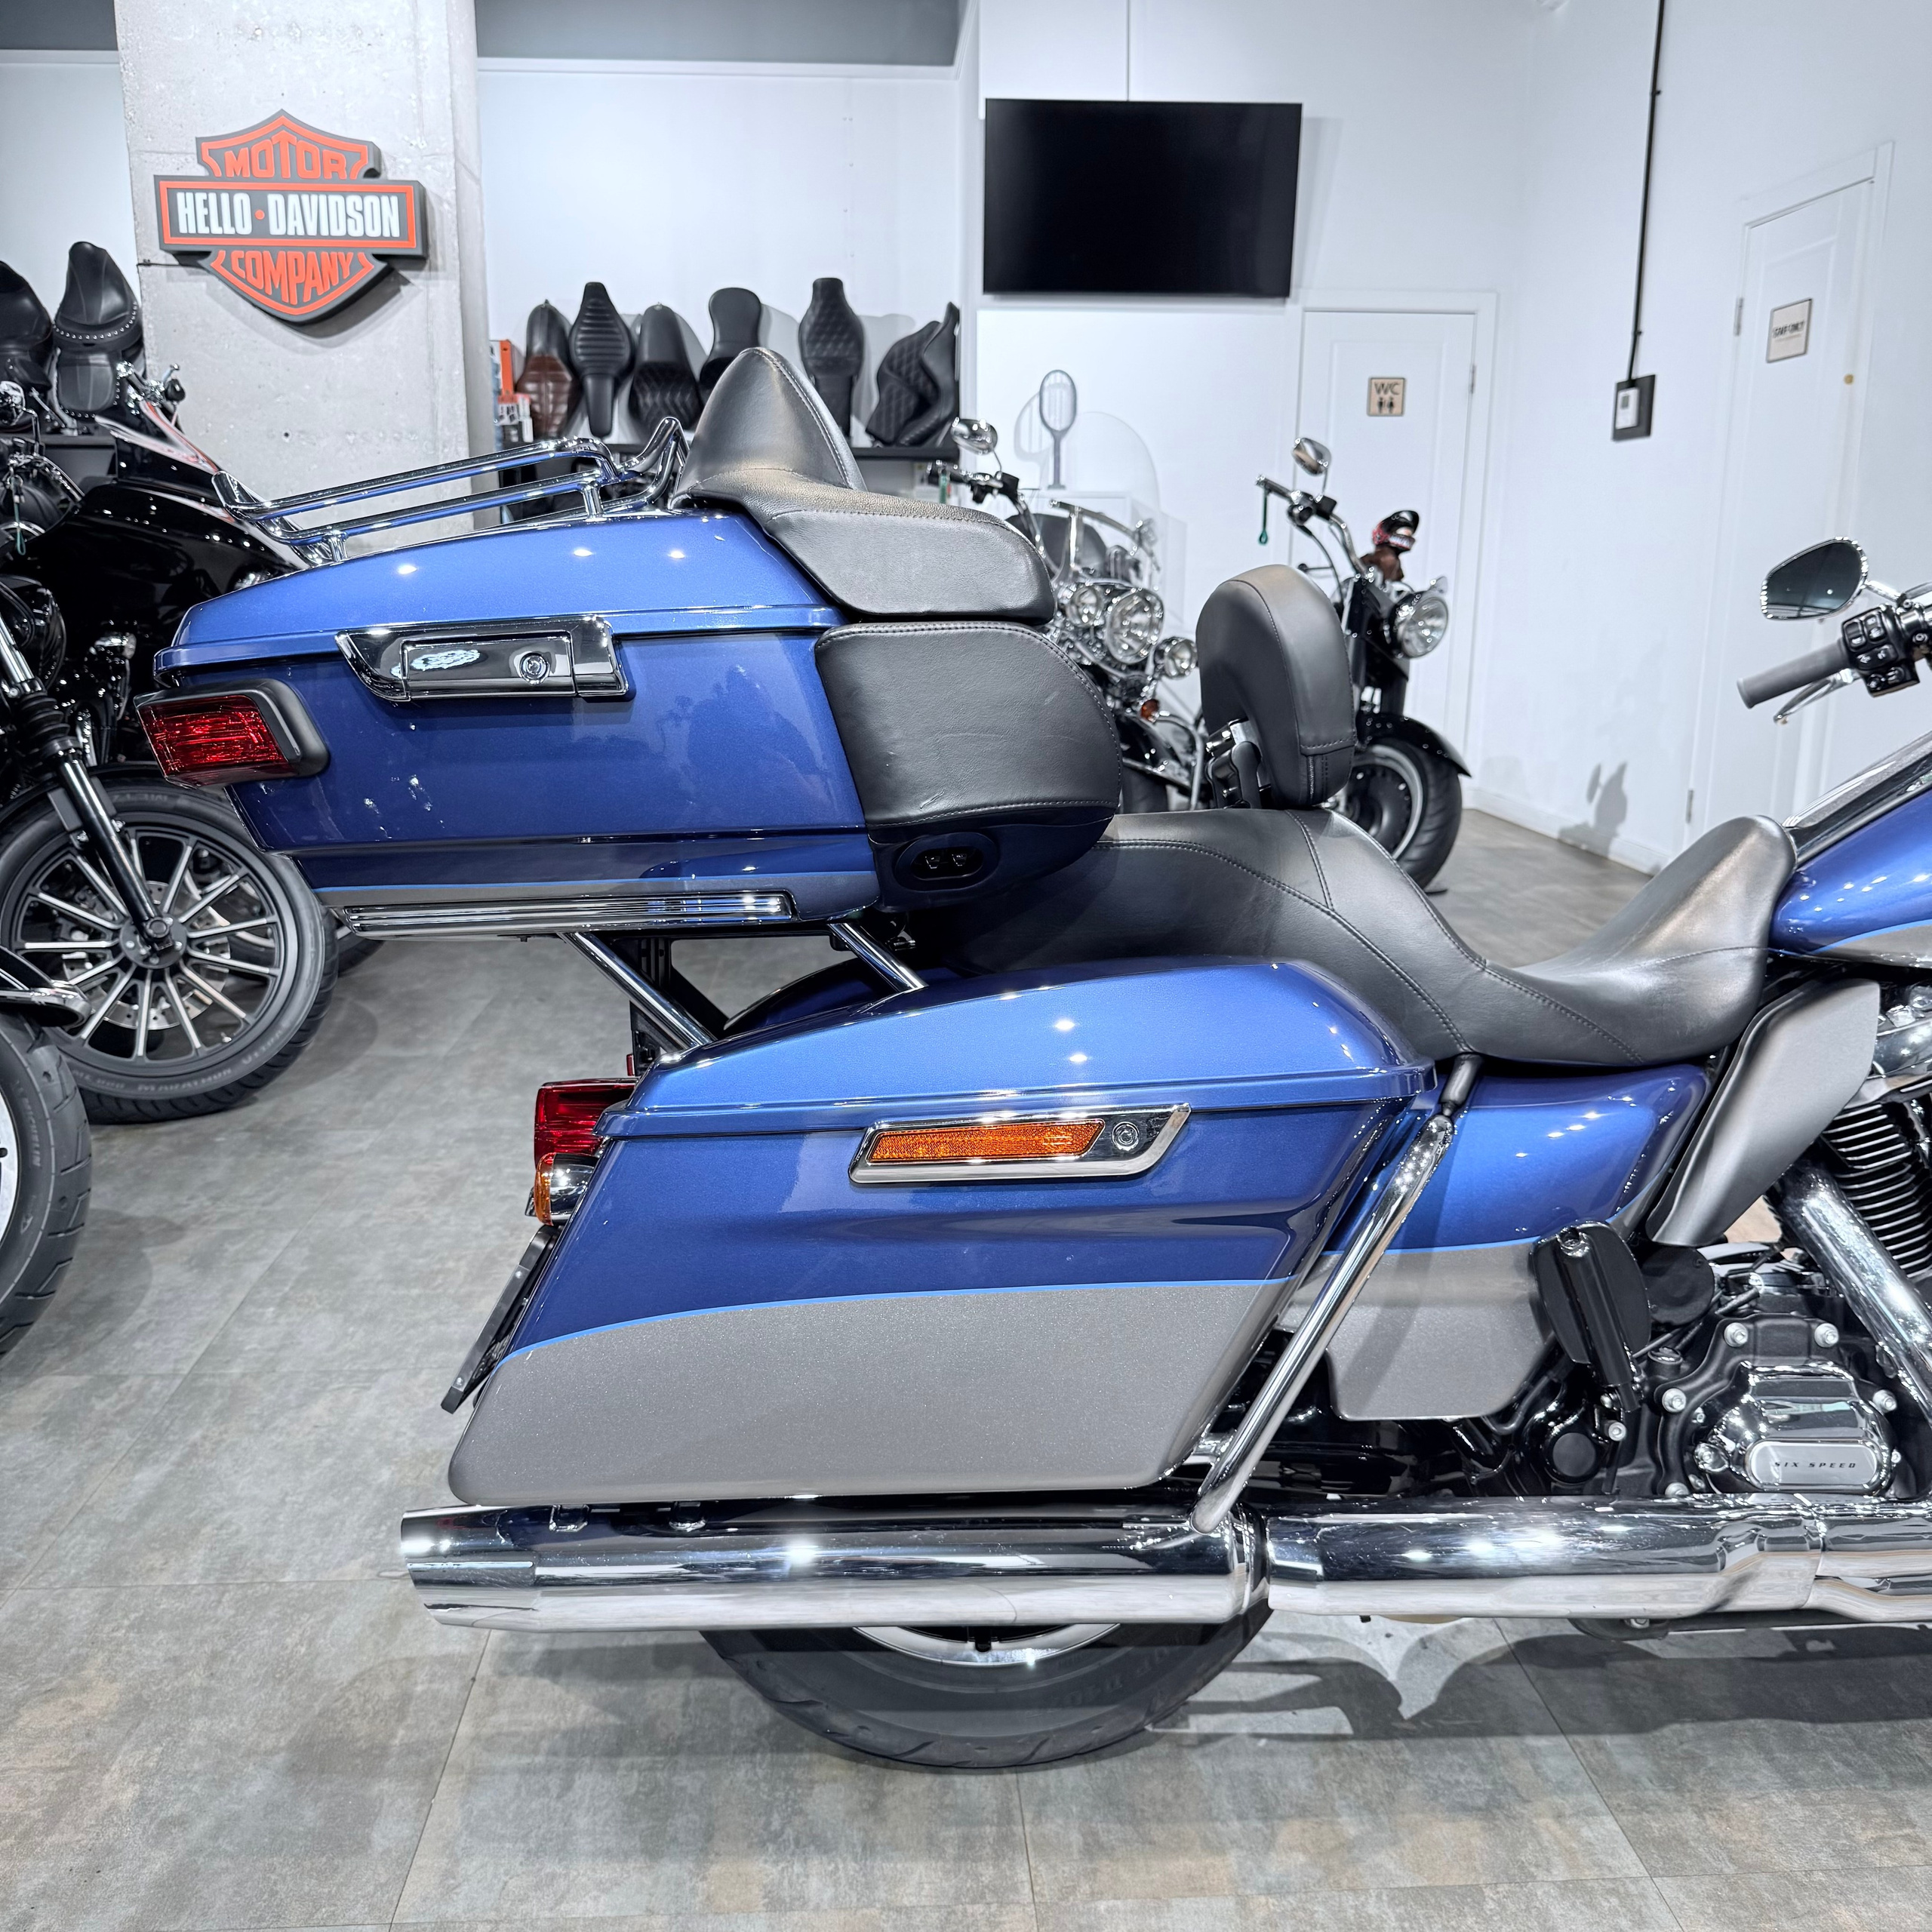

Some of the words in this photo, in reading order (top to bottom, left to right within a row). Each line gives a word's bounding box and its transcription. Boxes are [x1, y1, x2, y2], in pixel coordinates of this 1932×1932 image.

[224, 129, 348, 180] MOTOR
[176, 191, 253, 235] HELLO
[266, 192, 401, 238] DAVIDSON
[230, 250, 355, 305] COMPANY
[1374, 381, 1401, 395] WC
[1808, 1461, 1857, 1469] SPEED
